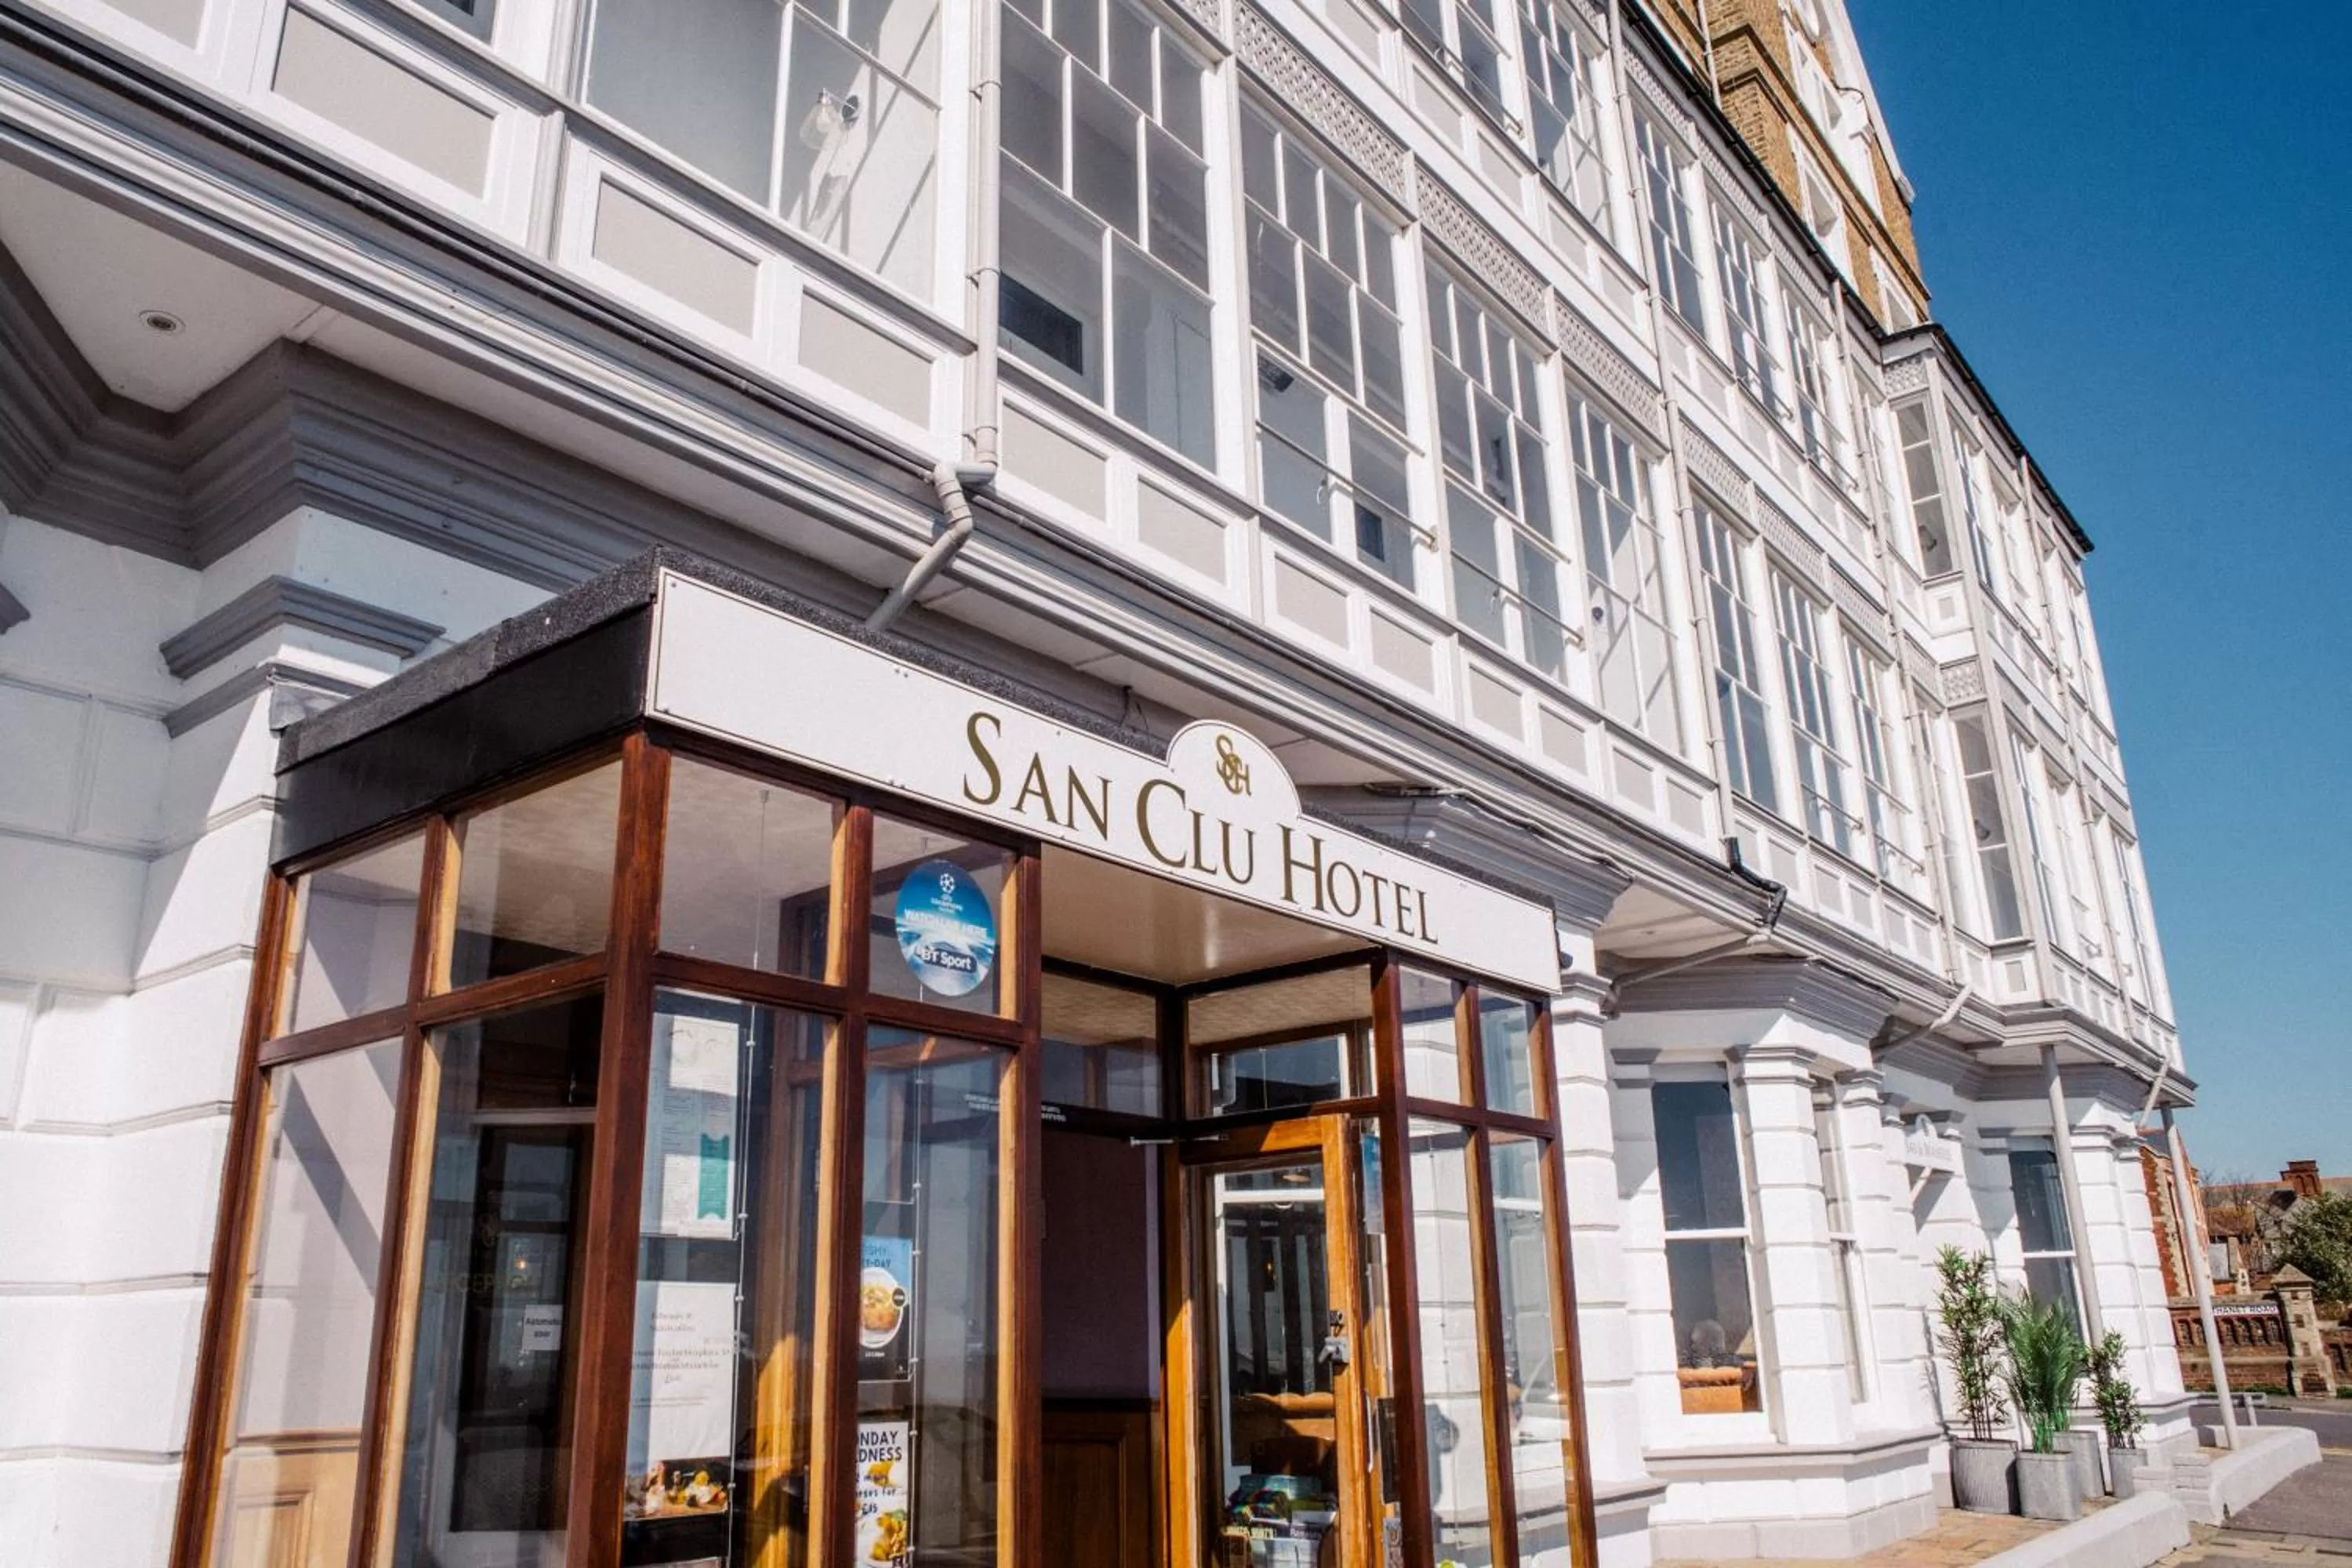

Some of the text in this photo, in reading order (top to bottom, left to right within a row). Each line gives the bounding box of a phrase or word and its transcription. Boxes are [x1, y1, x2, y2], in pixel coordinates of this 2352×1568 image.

[963, 711, 1439, 945] SAN CLU HOTEL
[941, 952, 972, 971] Sport
[2249, 1305, 2278, 1313] ROAD
[857, 1430, 899, 1446] NDAY
[856, 1446, 902, 1463] DNESS
